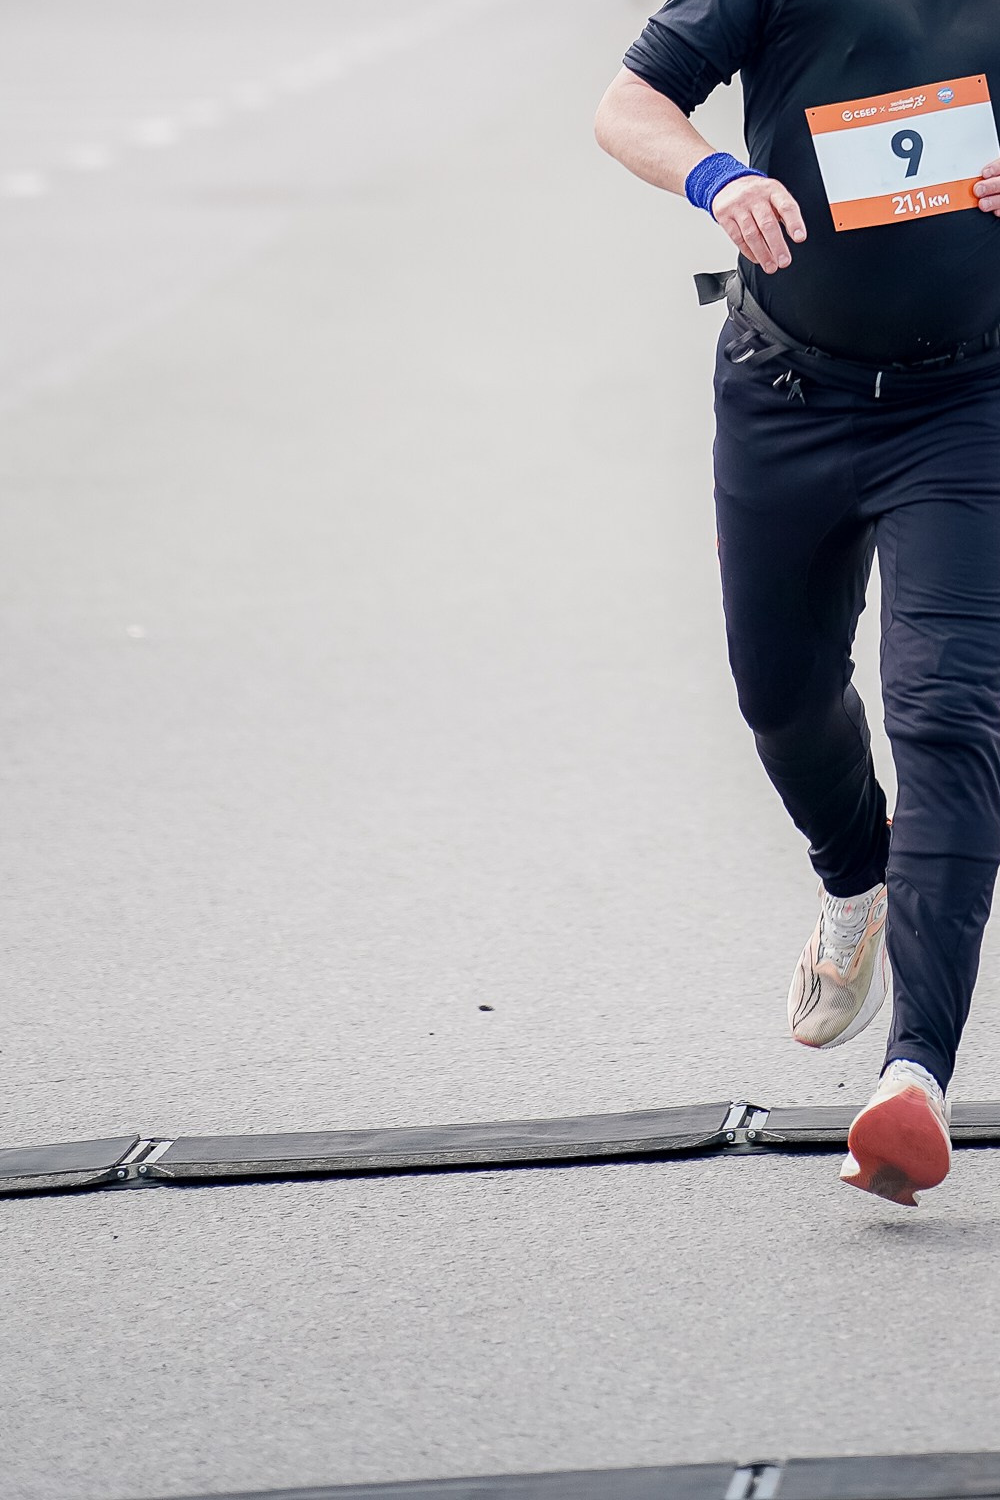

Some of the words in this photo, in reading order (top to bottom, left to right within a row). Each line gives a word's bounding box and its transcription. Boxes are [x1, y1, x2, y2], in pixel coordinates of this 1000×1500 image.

[853, 106, 878, 118] СБЕР
[891, 129, 924, 178] 9
[891, 191, 927, 215] 21,1
